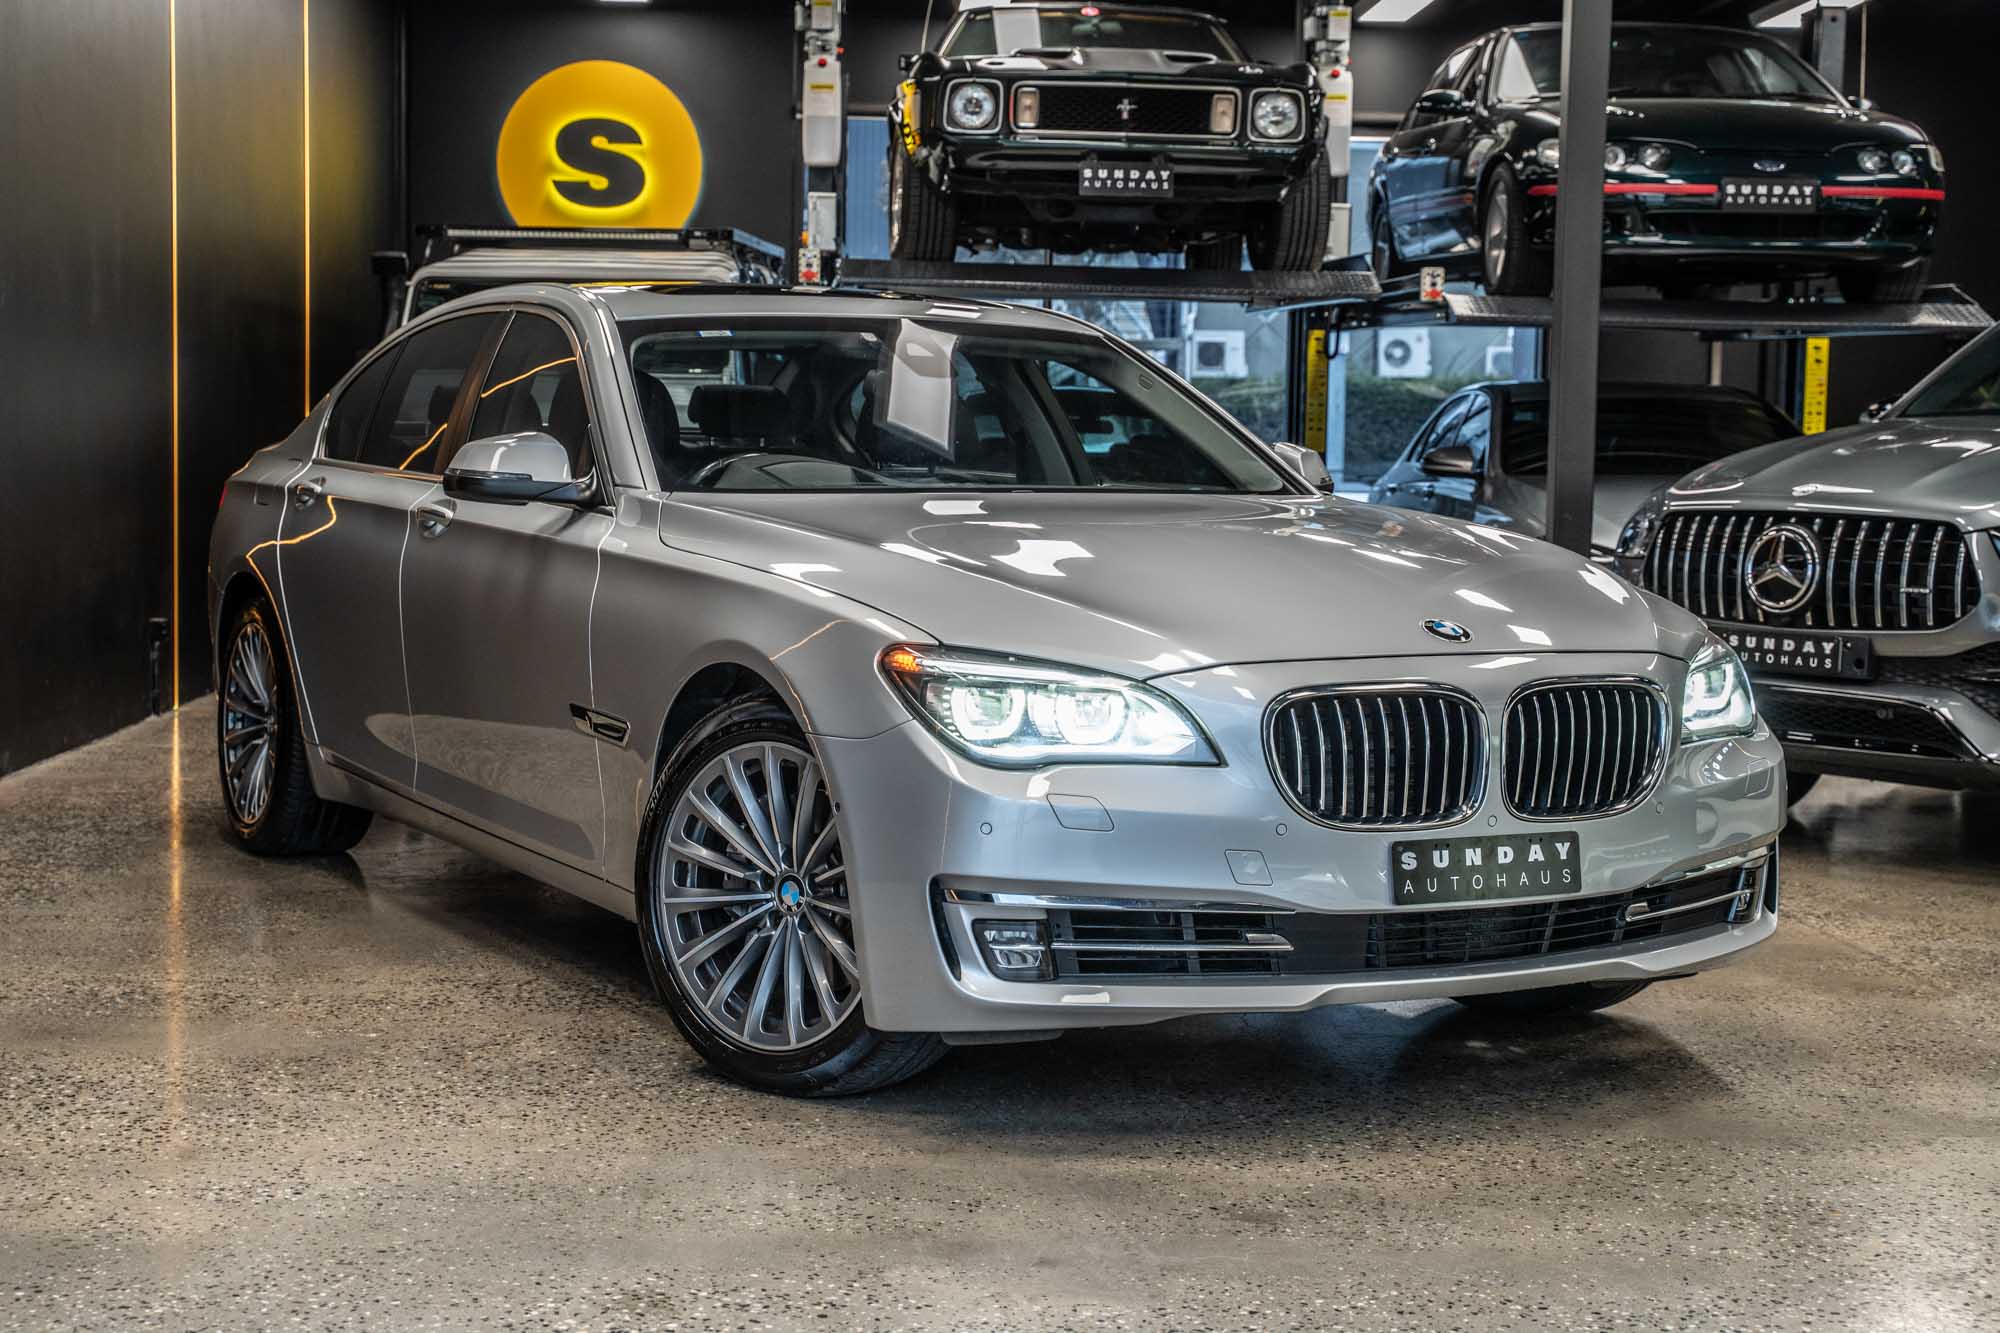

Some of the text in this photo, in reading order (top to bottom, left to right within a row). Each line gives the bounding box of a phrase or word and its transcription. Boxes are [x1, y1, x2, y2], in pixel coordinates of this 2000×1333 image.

[552, 118, 646, 208] S
[1083, 168, 1170, 180] SUNDAY
[1083, 180, 1169, 189] AUTOHAUS
[1726, 184, 1814, 195] SUNDAY
[1726, 195, 1812, 205] AUTOHAUS
[1729, 635, 1834, 654] SUNDAY
[1740, 652, 1833, 669] UTOHAUS
[1400, 842, 1571, 871] SUNDAY
[1403, 868, 1572, 894] AUTOHAUS
